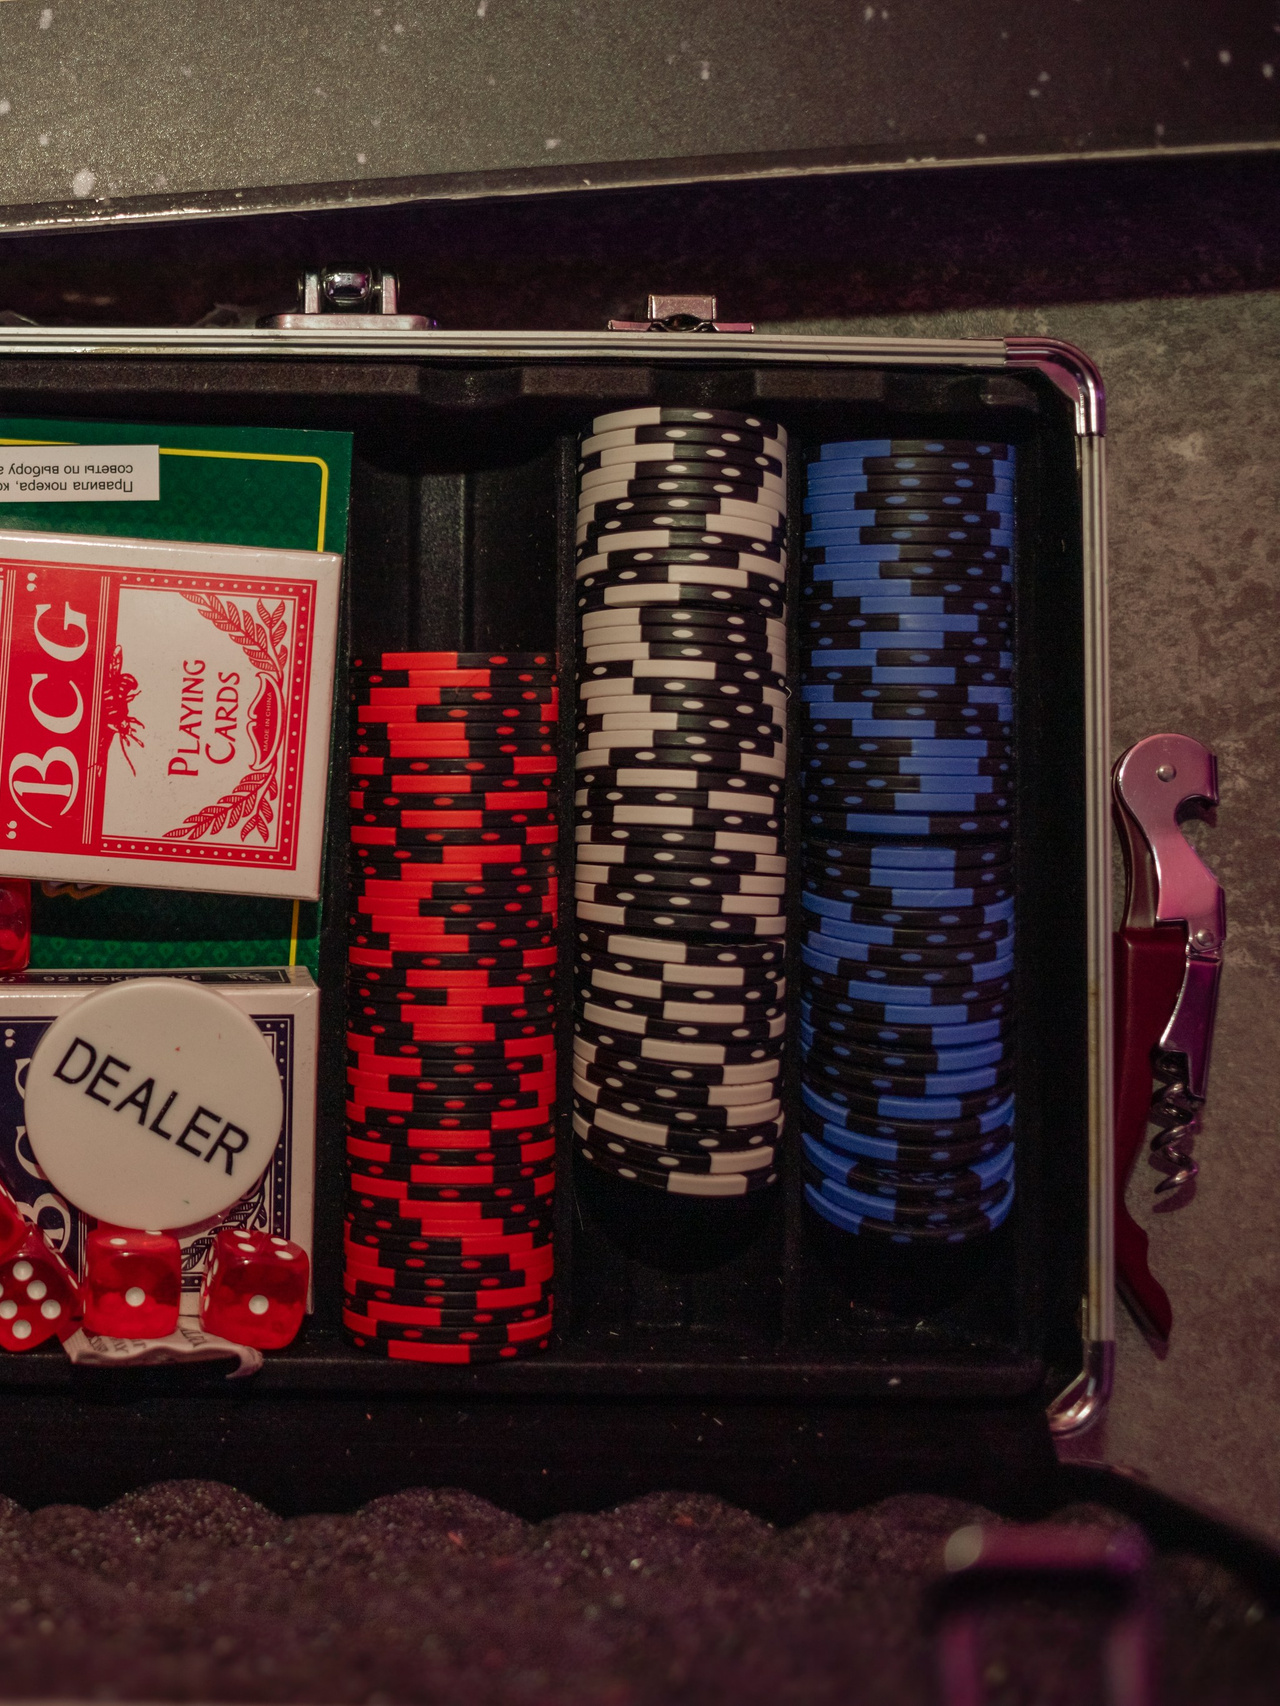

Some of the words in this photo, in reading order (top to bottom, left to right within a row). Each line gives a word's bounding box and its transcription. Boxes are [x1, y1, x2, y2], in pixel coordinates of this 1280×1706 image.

[8, 463, 59, 477] выбору
[63, 465, 80, 475] по
[84, 464, 133, 475] советы
[15, 480, 67, 491] покера,
[73, 479, 133, 493] Правила
[167, 660, 206, 776] PLAYING
[205, 672, 241, 764] CARDS
[265, 718, 271, 727] IN
[53, 1036, 249, 1176] DEALER
